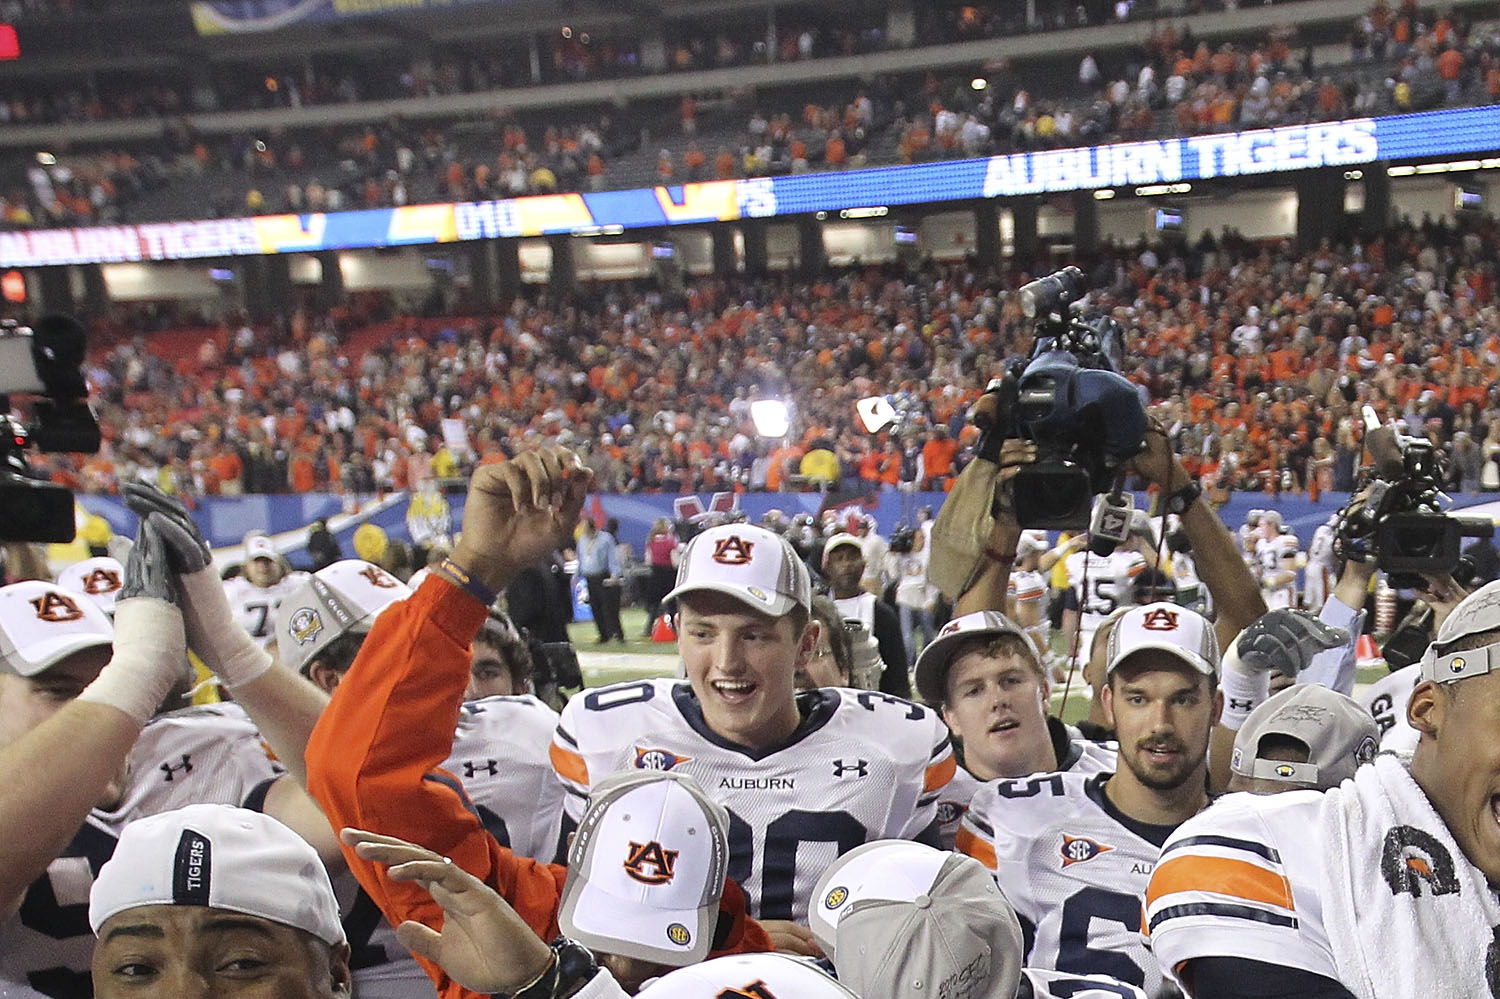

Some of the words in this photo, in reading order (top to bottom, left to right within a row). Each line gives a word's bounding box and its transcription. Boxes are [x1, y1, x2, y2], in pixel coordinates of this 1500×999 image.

[983, 137, 1183, 198] AUBURN
[1186, 116, 1379, 181] TIGERS
[138, 217, 262, 260] TIGERS
[1143, 608, 1179, 631] AU
[718, 777, 796, 791] AUBURN
[186, 840, 205, 891] TIGERS
[623, 841, 680, 886] AU
[711, 826, 722, 896] CHAMPIONS
[1067, 839, 1092, 861] SEC
[671, 926, 687, 942] SEC
